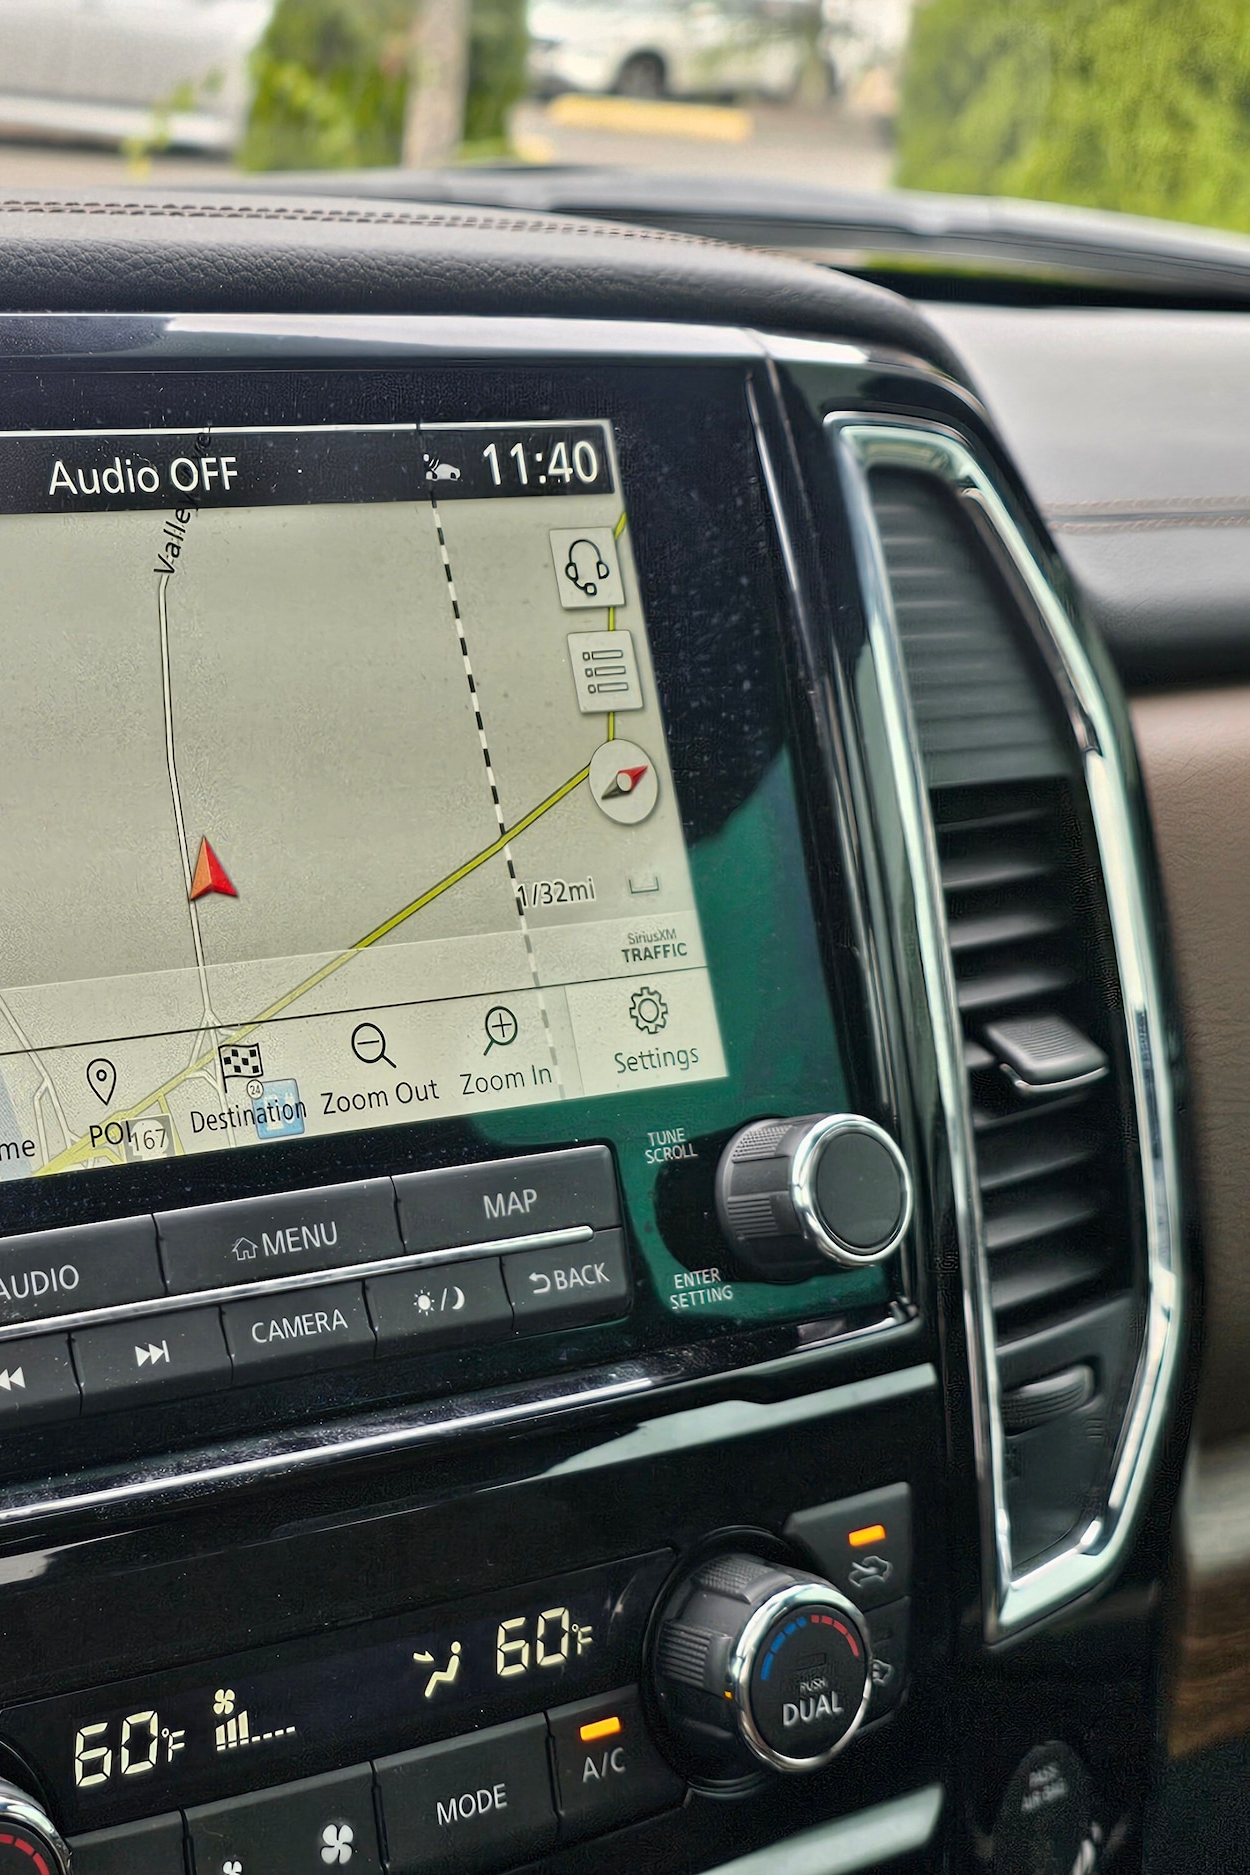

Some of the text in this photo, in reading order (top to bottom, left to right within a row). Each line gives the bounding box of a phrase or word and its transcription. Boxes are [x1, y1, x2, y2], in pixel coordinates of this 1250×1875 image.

[49, 456, 160, 496] Audio
[171, 457, 238, 491] OFF
[482, 441, 598, 485] 11:40
[517, 877, 595, 907] 1/32mi
[627, 928, 677, 945] SiriusXM
[621, 942, 688, 963] TRAFFIC
[614, 1046, 699, 1076] Settings
[460, 1065, 553, 1096] Zoom In
[321, 1079, 440, 1117] Zoom Out
[190, 1098, 307, 1134] Destination
[89, 1120, 131, 1147] POI
[131, 1128, 167, 1151] 167
[647, 1128, 687, 1147] TUNE
[645, 1143, 699, 1164] SCROLL
[482, 1188, 538, 1220] MAP
[262, 1221, 338, 1258] MENU
[553, 1262, 610, 1292] BACK
[673, 1267, 721, 1291] ENTER
[669, 1284, 734, 1311] SETTING
[251, 1308, 349, 1345] CAMERA
[782, 1690, 845, 1727] DUAL
[580, 1747, 626, 1784] A/C
[436, 1784, 508, 1828] MODE
